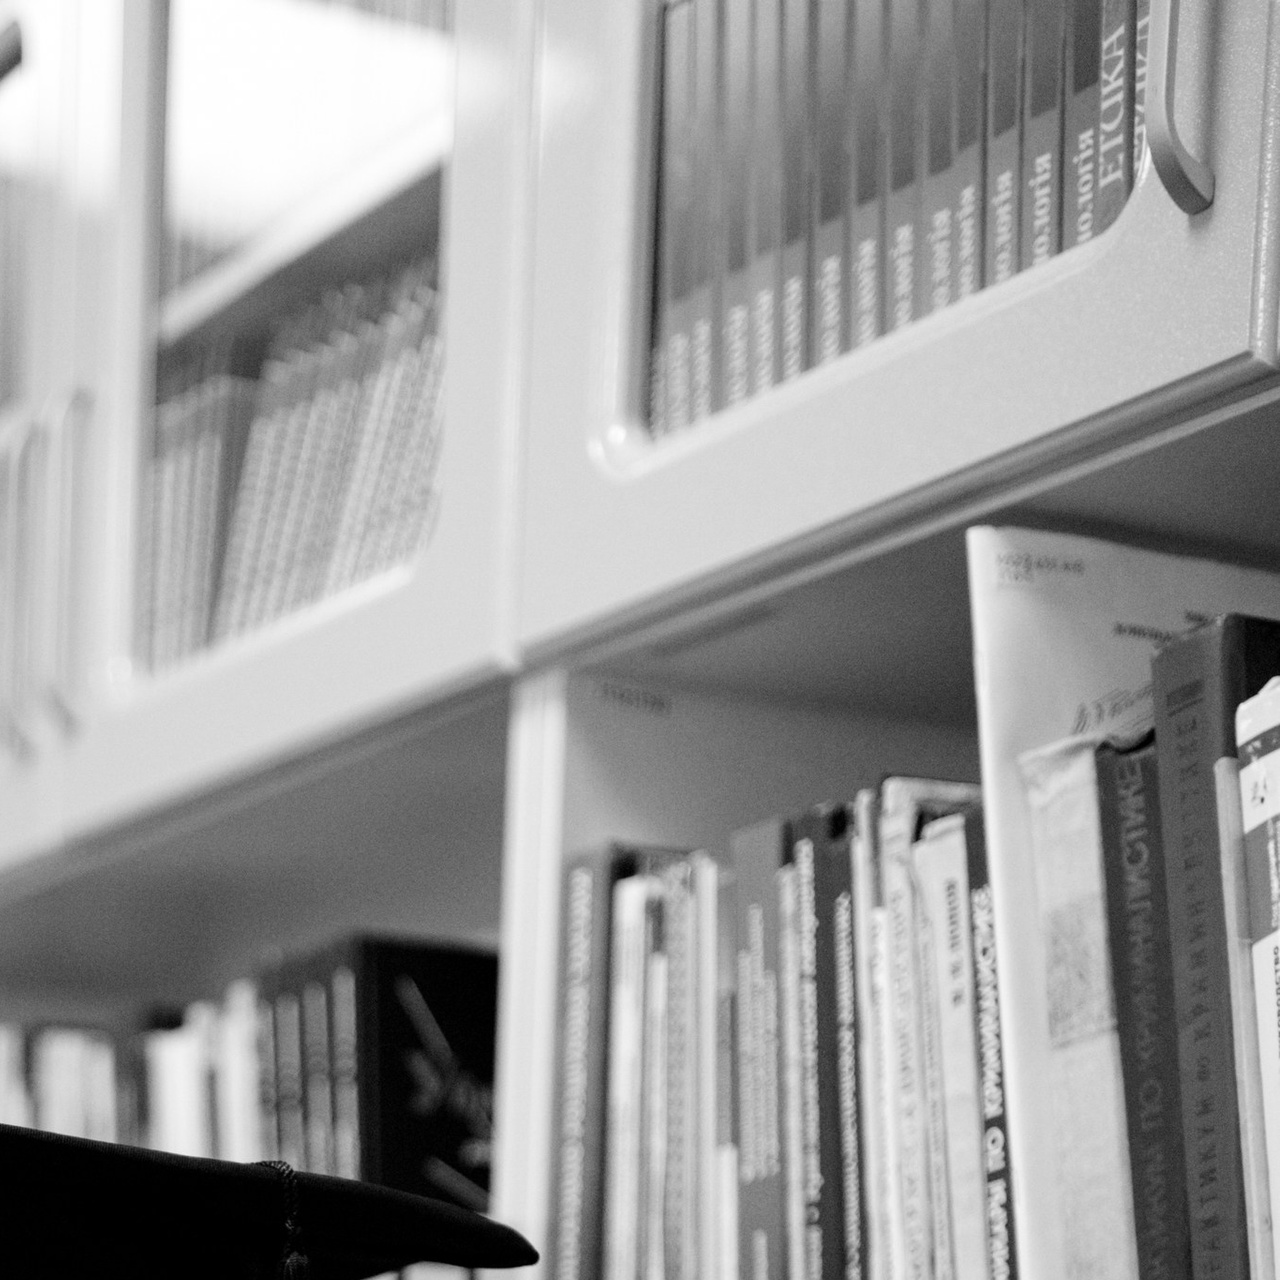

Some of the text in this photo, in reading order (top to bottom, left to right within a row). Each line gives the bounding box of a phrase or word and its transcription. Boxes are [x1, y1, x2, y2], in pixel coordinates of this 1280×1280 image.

[1113, 755, 1161, 1063] КРИМИНАЛИСТИКЕ
[969, 884, 1003, 1121] КРИМИНАЛИСТИКЕ
[982, 1127, 1006, 1176] ПО
[1134, 1082, 1162, 1131] ПО
